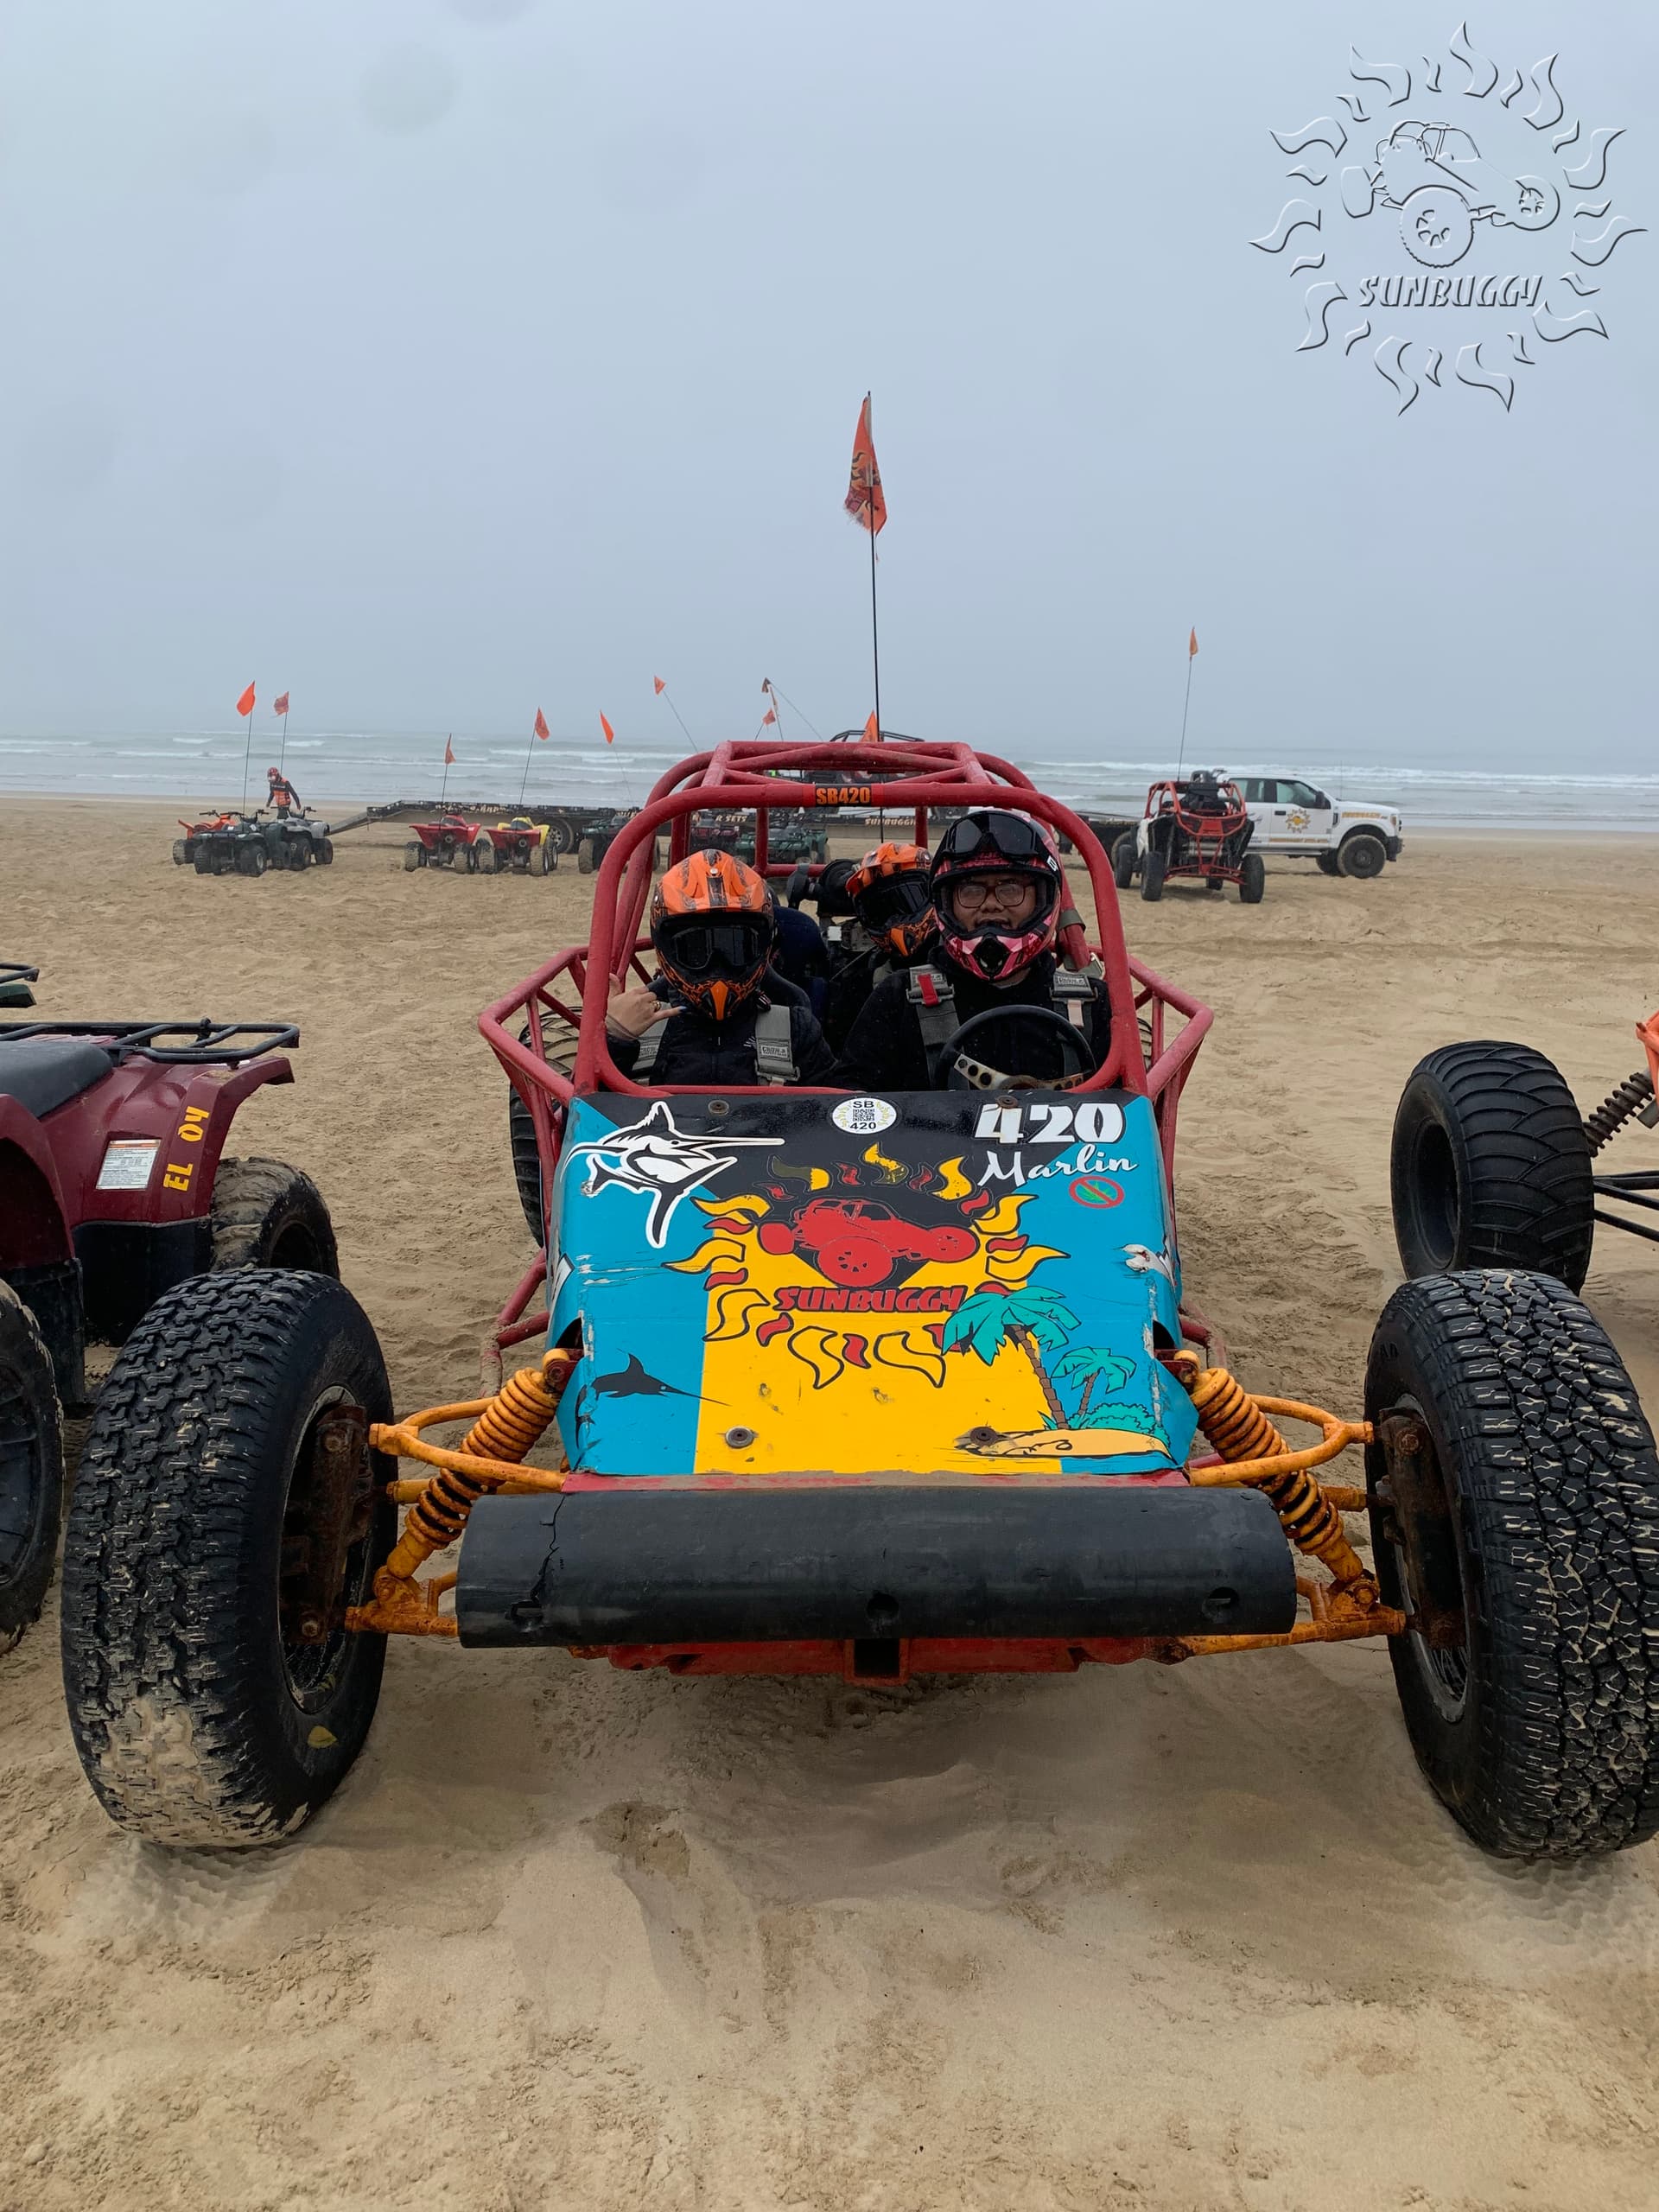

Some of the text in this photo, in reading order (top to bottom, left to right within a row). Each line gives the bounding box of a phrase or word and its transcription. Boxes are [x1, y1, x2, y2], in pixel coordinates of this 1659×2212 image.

[816, 787, 871, 804] SB420
[849, 1122, 877, 1130] 420
[974, 1102, 1124, 1144] 420
[977, 1144, 1138, 1187] Marlin
[775, 1286, 966, 1312] SUNBUGGY
